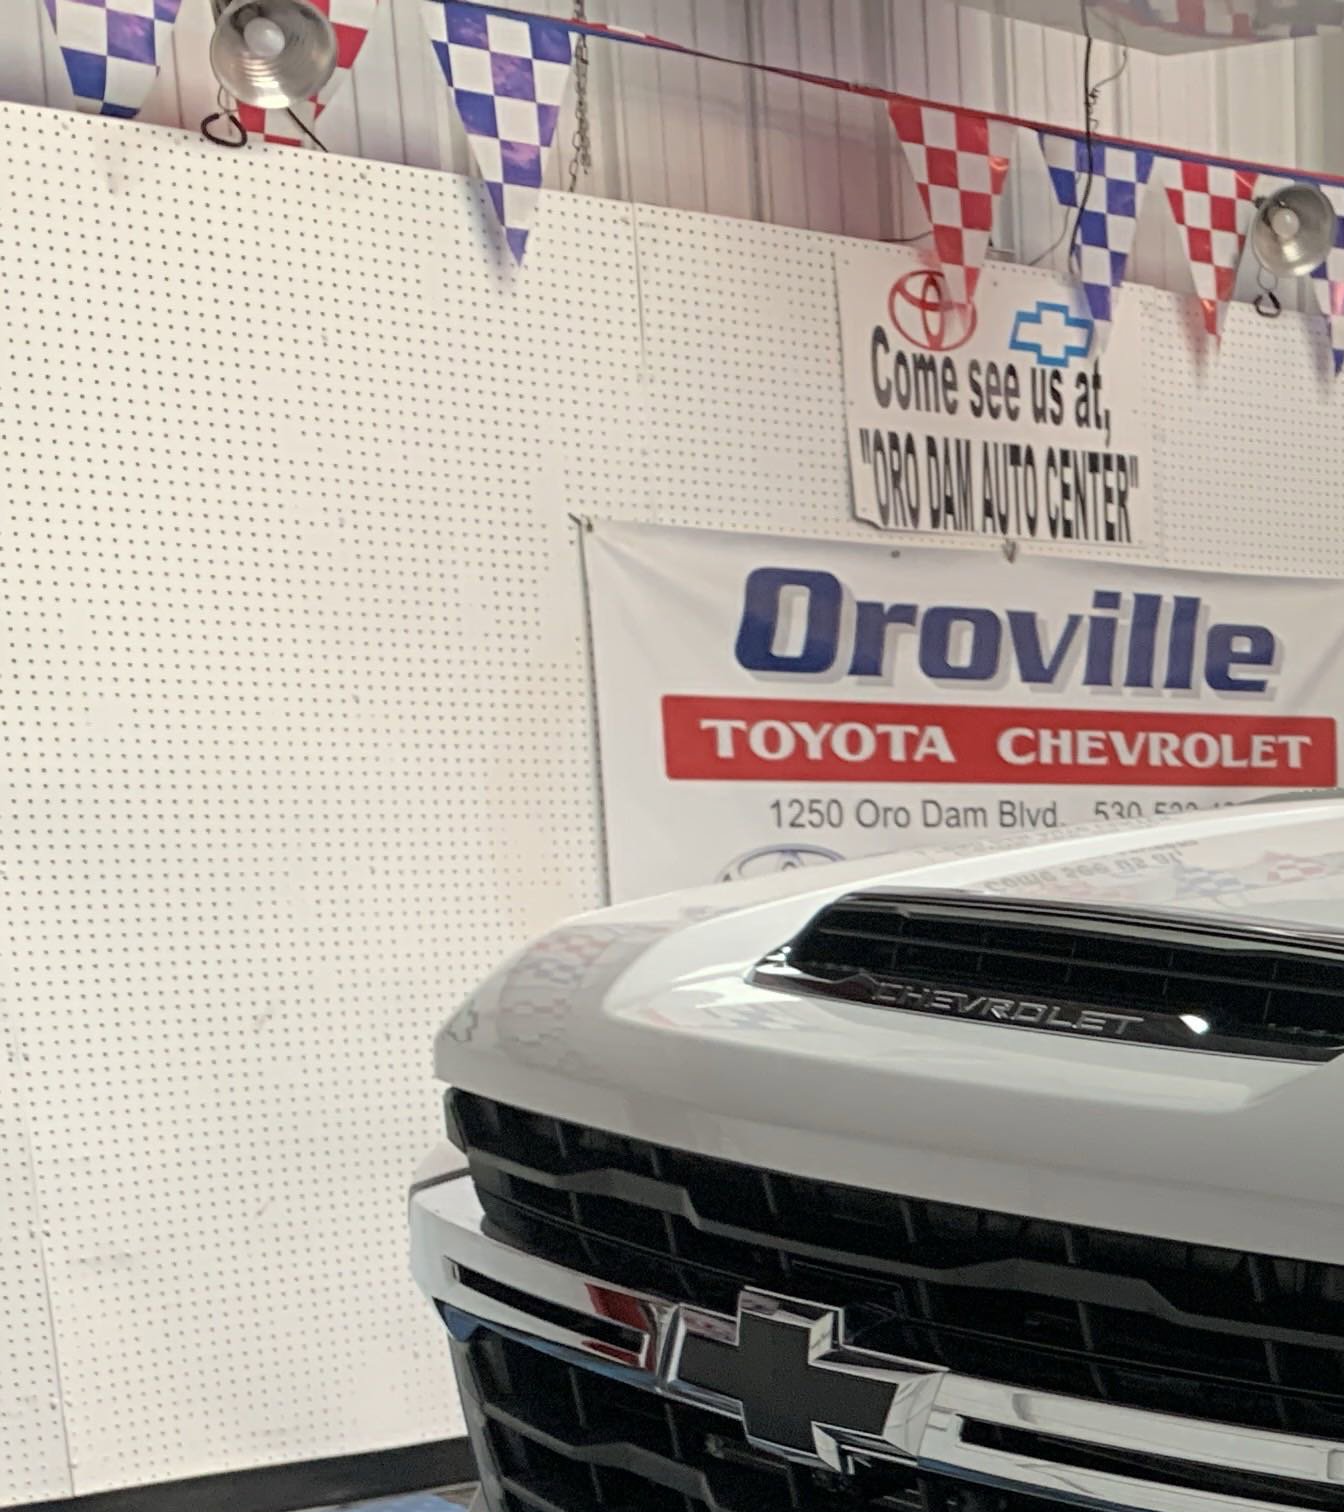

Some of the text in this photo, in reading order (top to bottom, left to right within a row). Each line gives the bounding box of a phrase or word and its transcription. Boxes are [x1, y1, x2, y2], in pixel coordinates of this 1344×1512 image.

[871, 325, 1112, 448] Come see us at,
[859, 427, 1139, 543] "ORO DAM AUTO CENTER"
[735, 567, 1278, 693] Oroville
[700, 719, 1312, 769] TOYOTA CHEVROLET
[770, 799, 843, 828] 1250
[856, 799, 911, 828] Oro
[922, 799, 988, 828] Dam
[873, 983, 1145, 1034] CHEVROLET
